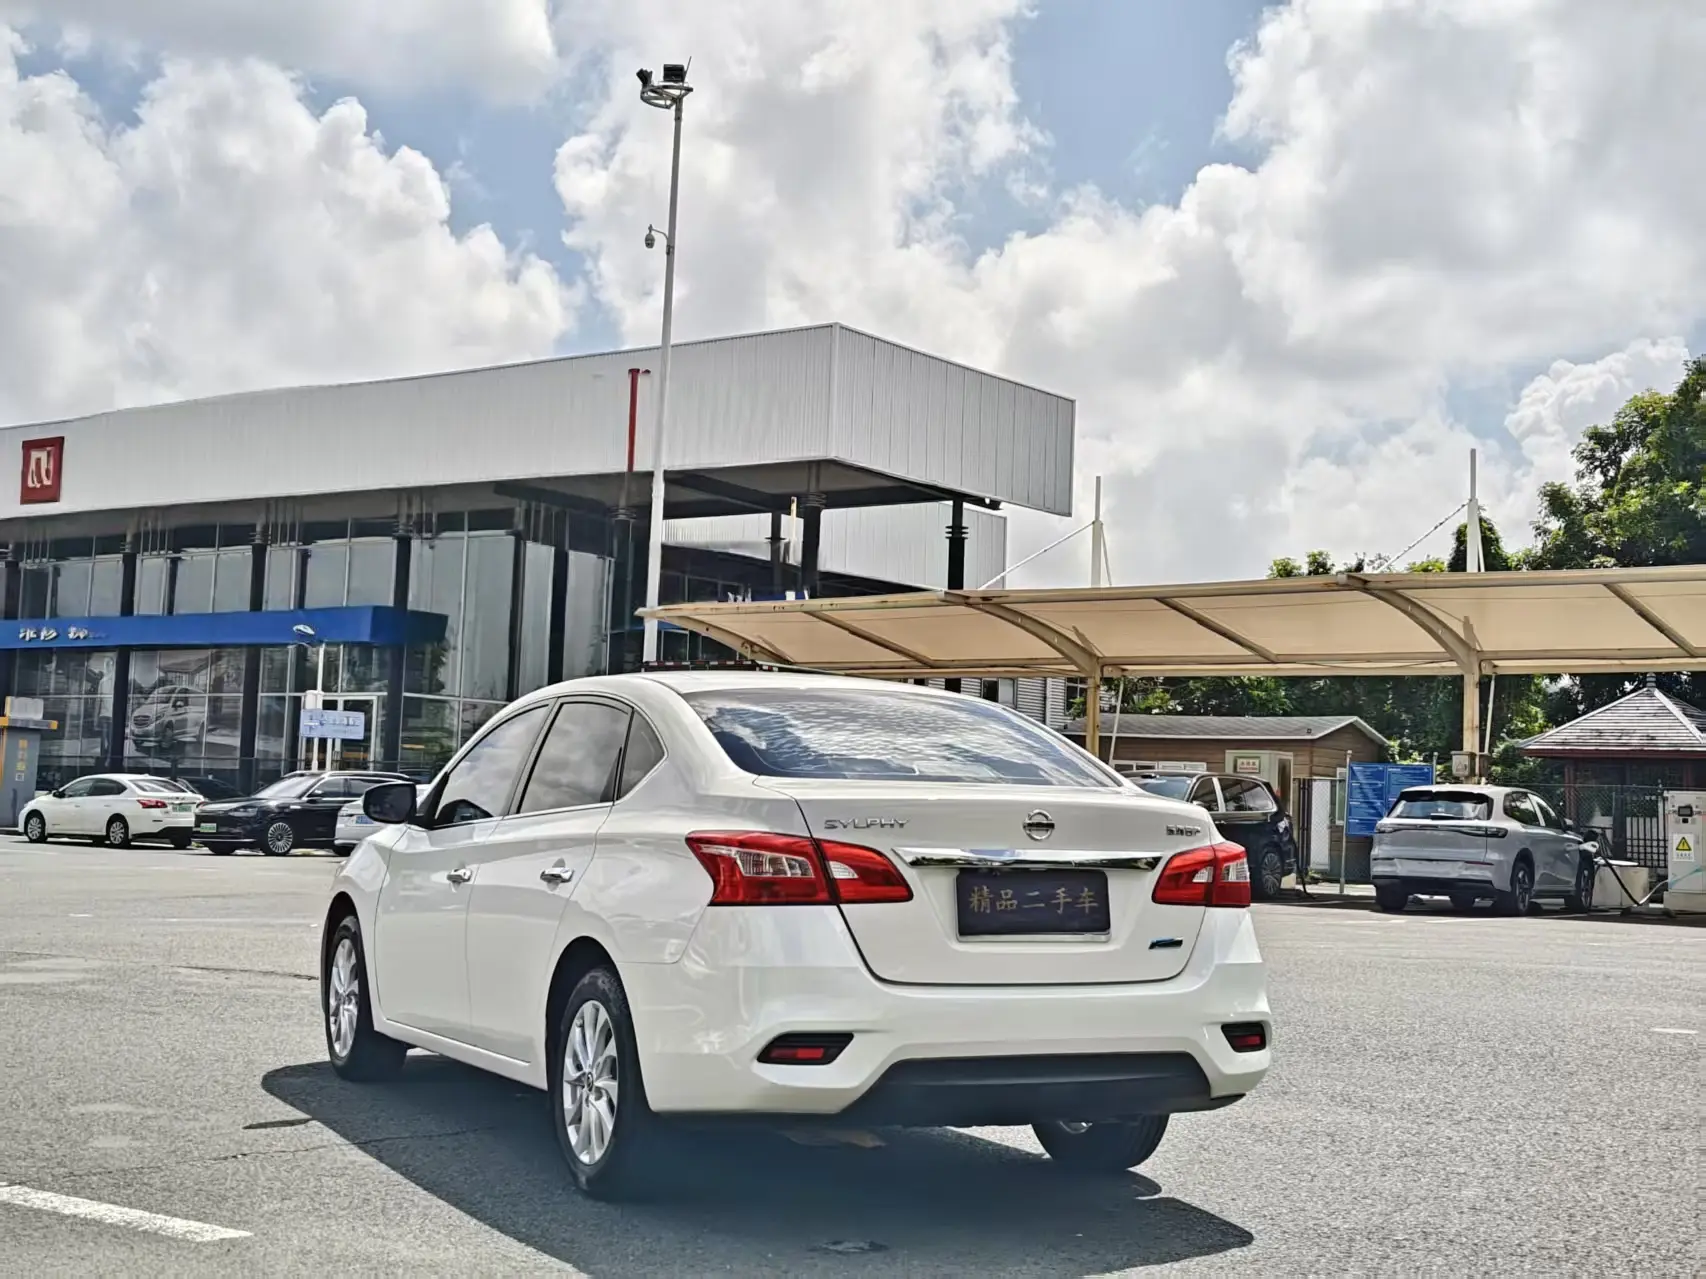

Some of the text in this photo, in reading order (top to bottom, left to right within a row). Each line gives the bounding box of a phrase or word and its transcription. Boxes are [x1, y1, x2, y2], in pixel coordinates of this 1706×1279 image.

[824, 817, 909, 830] SYLPHY
[968, 885, 1100, 914] 精品二手车
